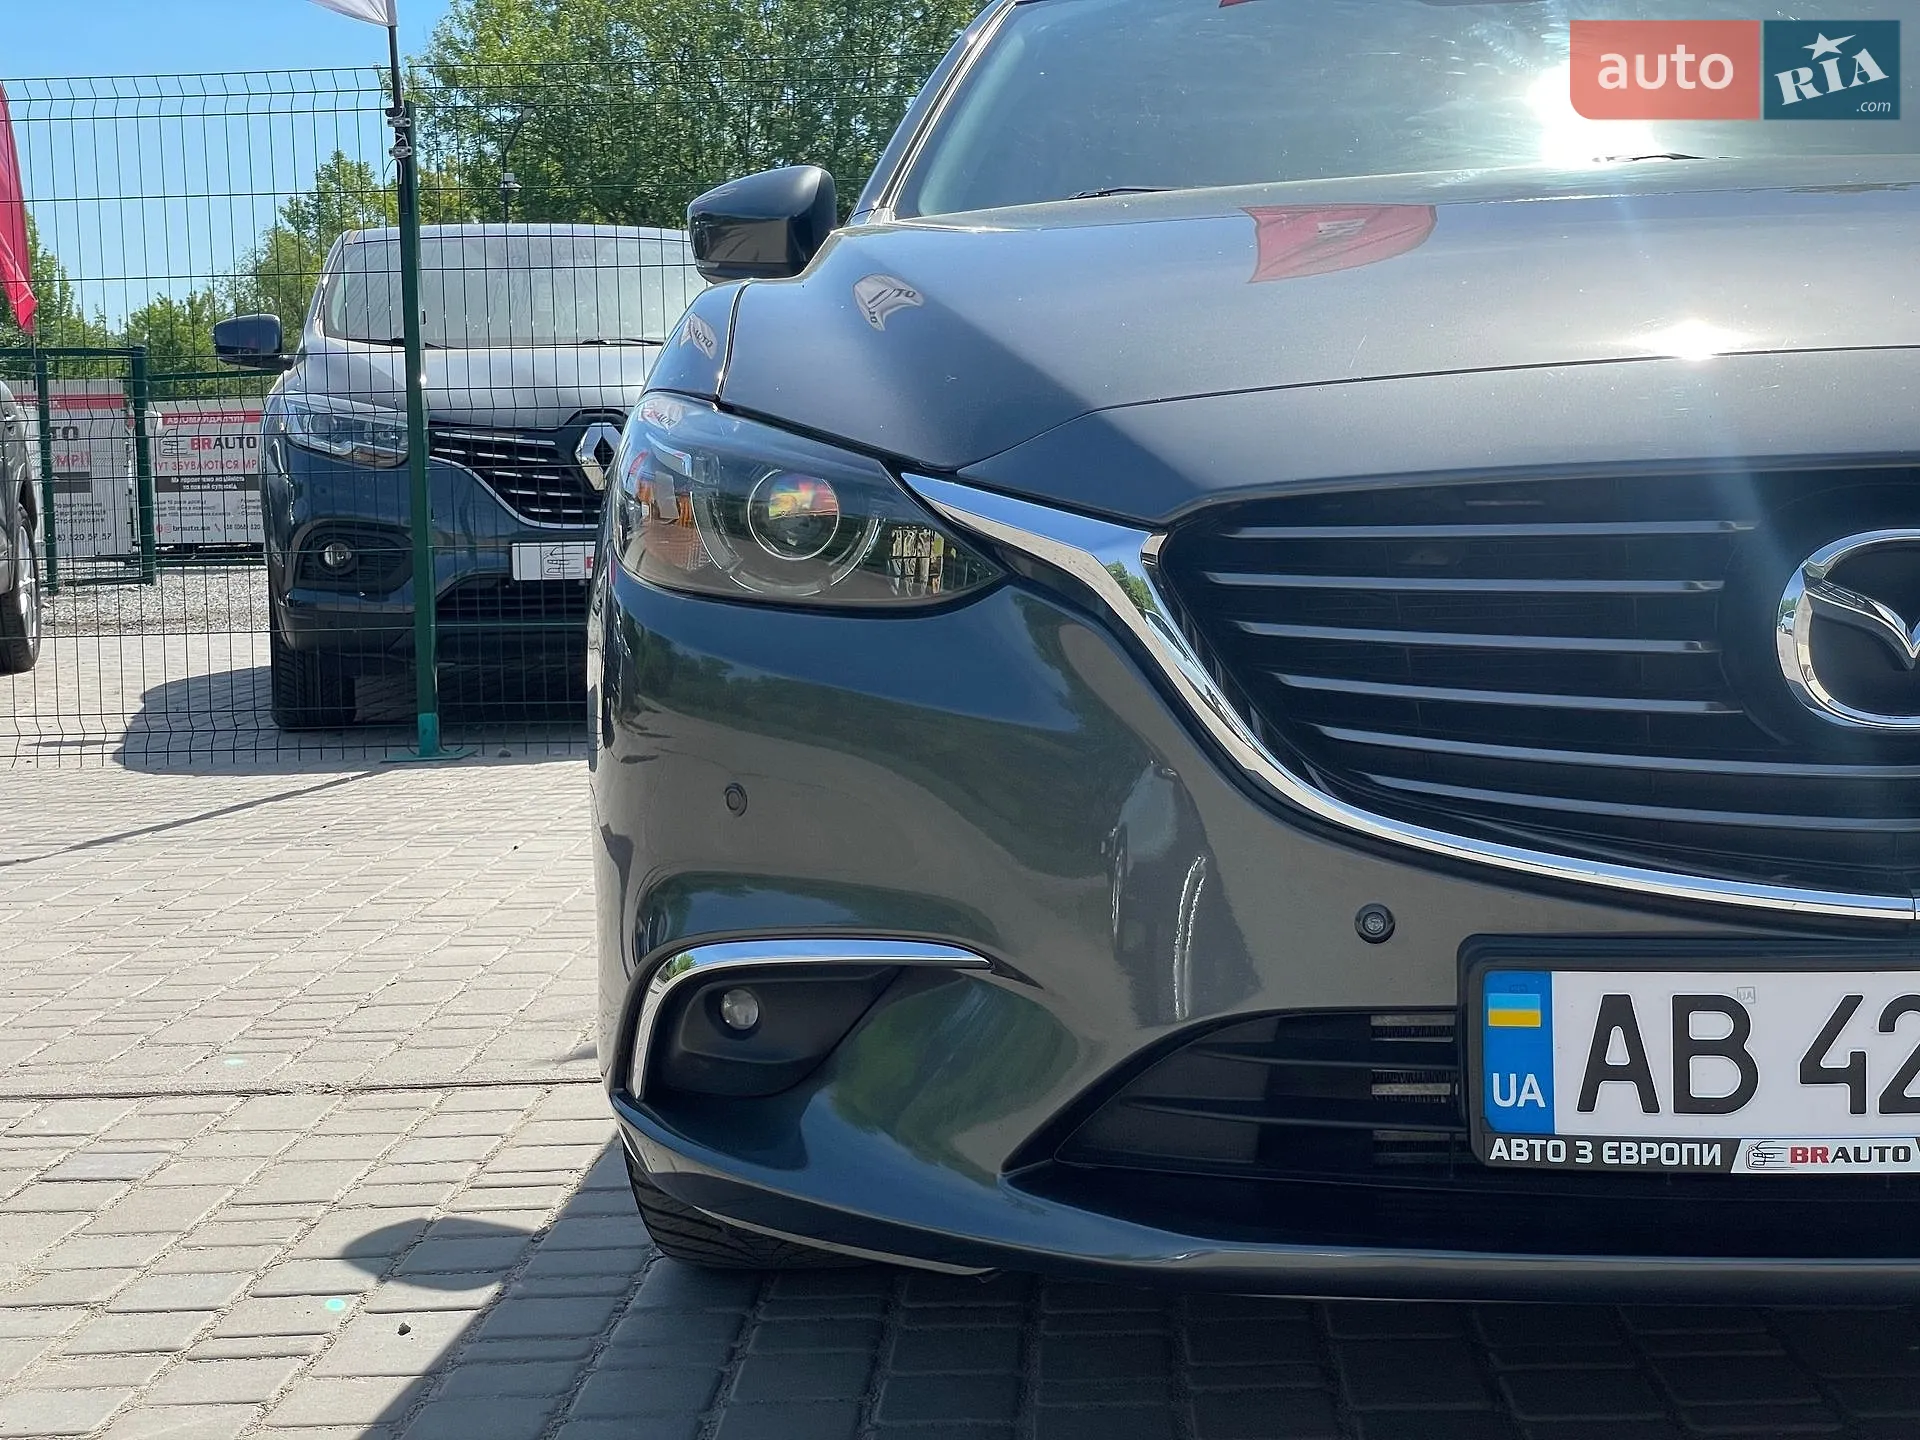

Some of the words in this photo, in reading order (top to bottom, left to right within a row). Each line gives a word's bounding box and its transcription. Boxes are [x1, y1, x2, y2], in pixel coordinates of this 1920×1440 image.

[191, 437, 257, 450] BRAUTO
[155, 462, 168, 471] УТ
[1576, 993, 1759, 1115] AB
[1492, 1073, 1546, 1109] UA
[1489, 1138, 1567, 1164] АВТО
[1602, 1141, 1722, 1167] ЄВРОПИ
[1789, 1145, 1911, 1164] BRAUTO
